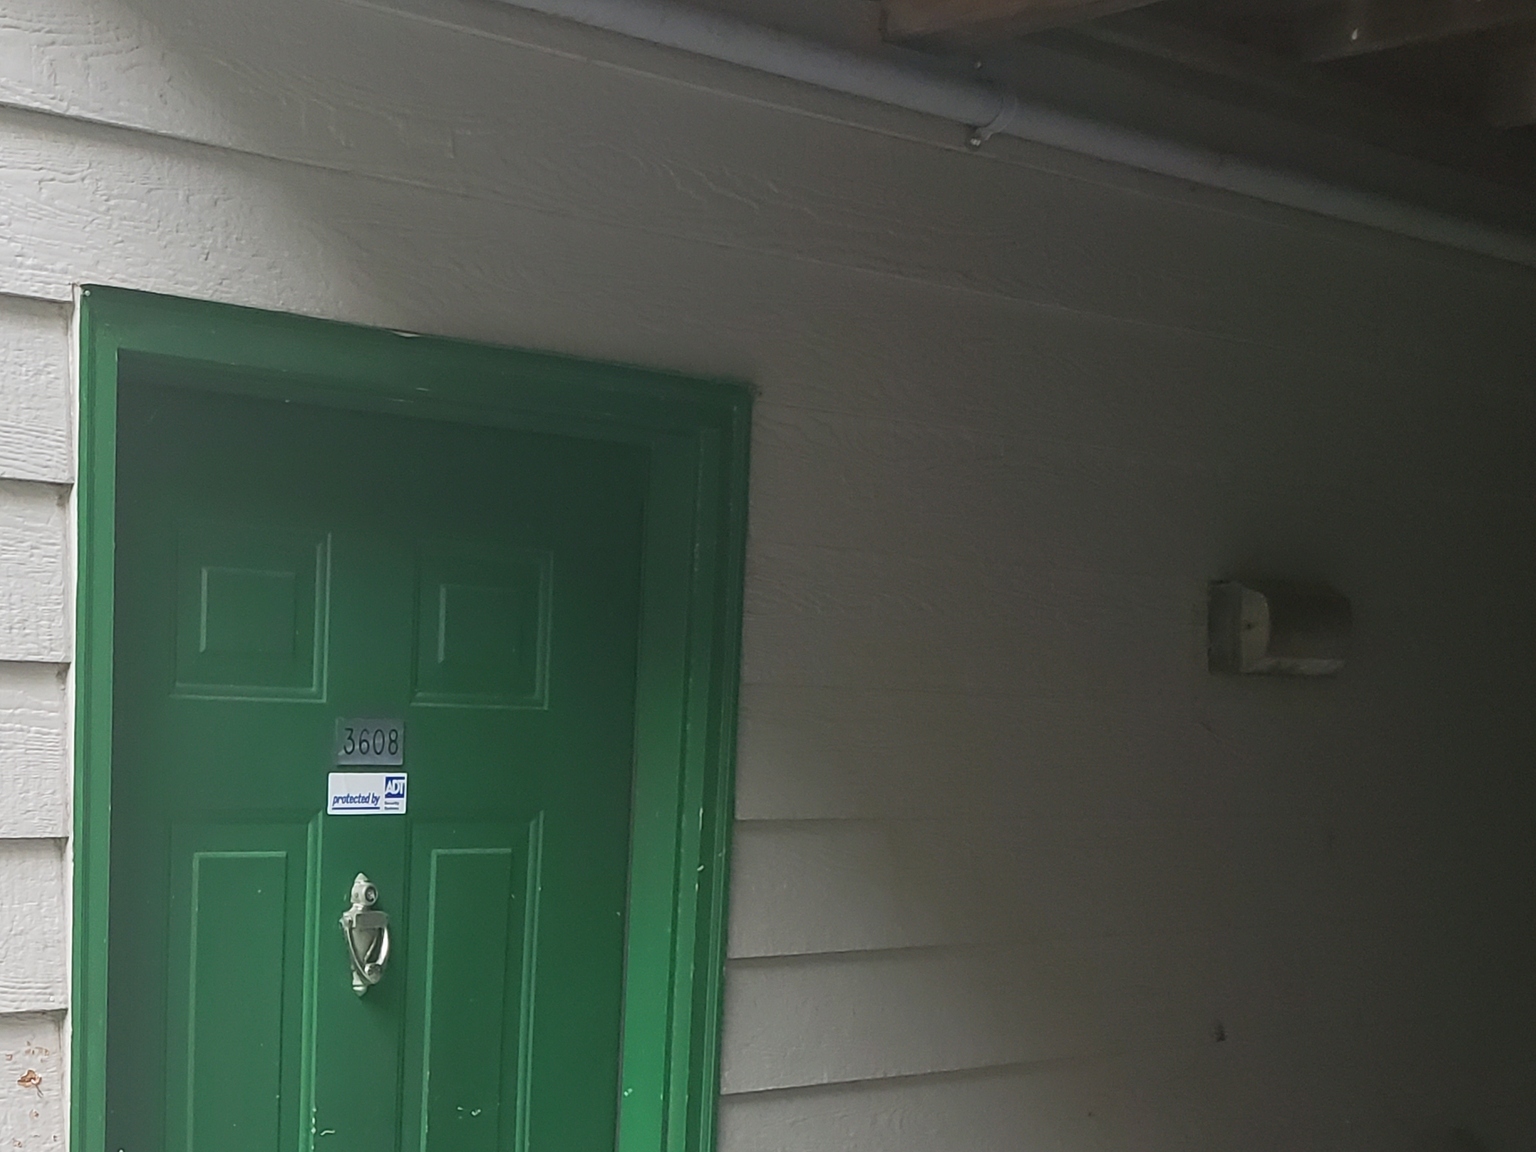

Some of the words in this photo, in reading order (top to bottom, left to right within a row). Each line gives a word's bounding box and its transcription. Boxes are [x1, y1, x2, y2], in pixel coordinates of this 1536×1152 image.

[343, 727, 399, 755] 3608
[385, 779, 405, 795] ADT
[332, 792, 371, 807] protected
[371, 793, 381, 807] by
